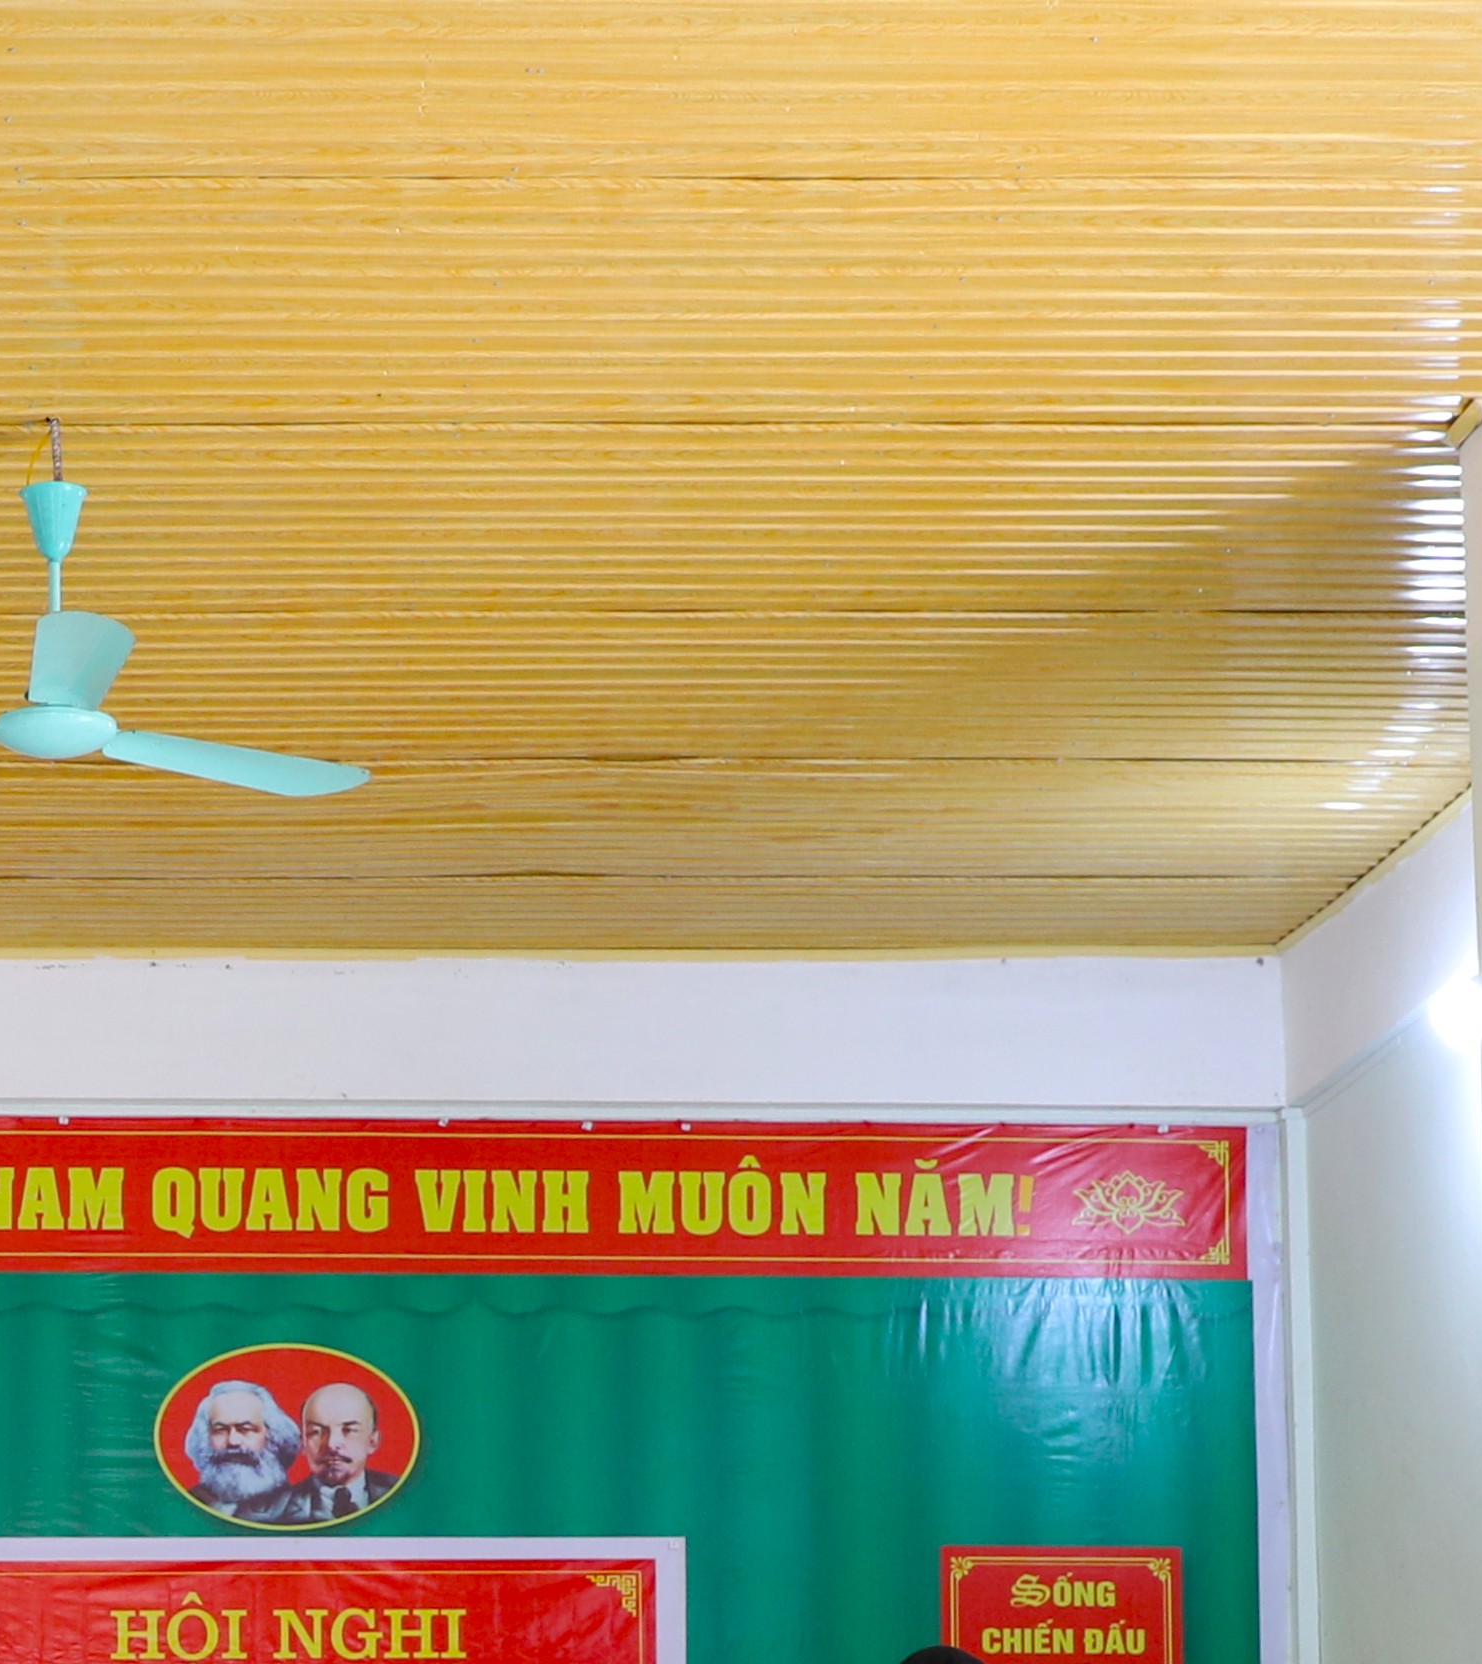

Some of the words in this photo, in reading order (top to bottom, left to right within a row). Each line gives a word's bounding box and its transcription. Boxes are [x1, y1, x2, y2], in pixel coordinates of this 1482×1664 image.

[152, 1167, 389, 1238] QUANG
[415, 1166, 589, 1236] VINH
[618, 1155, 826, 1235] MUÔN
[855, 1159, 1033, 1235] NĂM!
[1010, 1571, 1116, 1608] SỐNG
[982, 1620, 1074, 1653] CHIẾN
[1084, 1620, 1145, 1654] ĐẤU
